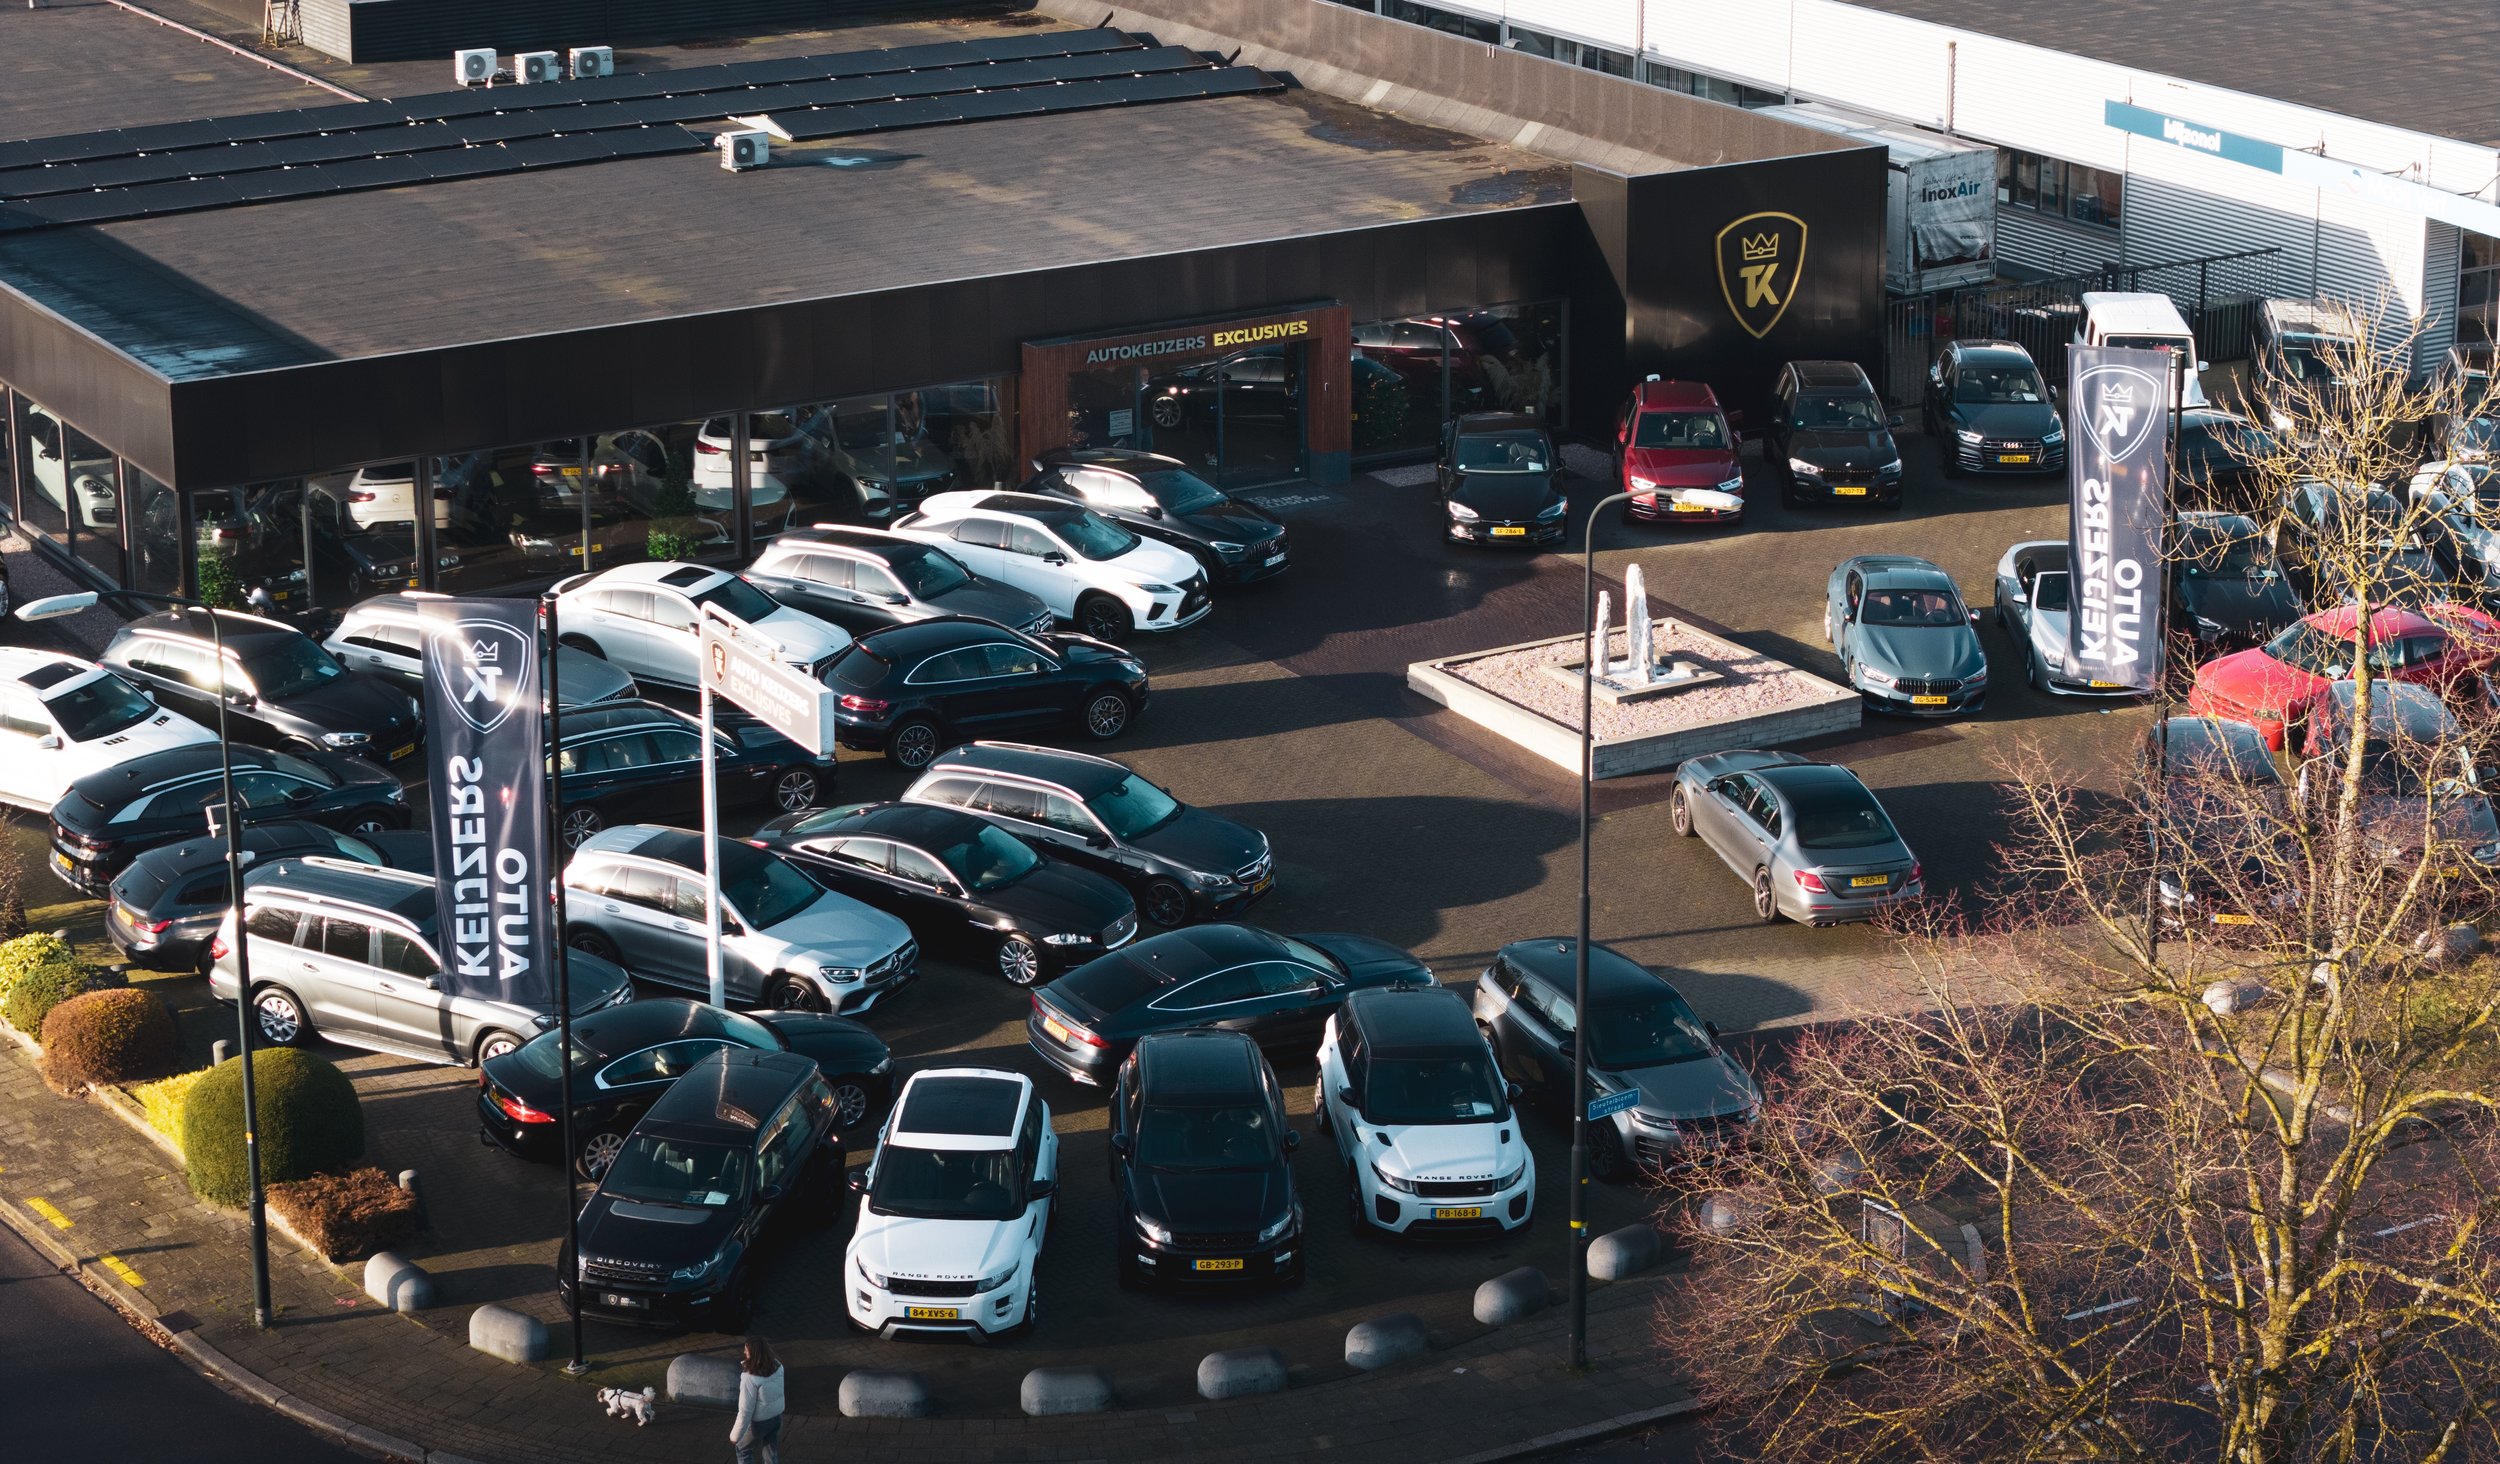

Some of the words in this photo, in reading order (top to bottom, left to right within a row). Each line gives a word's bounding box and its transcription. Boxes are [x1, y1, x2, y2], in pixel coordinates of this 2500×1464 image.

[1922, 180, 1981, 203] InoxAir
[1087, 335, 1206, 364] AUTOKEIJZERS
[1213, 320, 1309, 347] EXCLUSIVES
[730, 656, 760, 684] AUTO
[731, 675, 792, 726] EXCLUSIVES
[1855, 876, 1885, 885] T-560-TT
[1604, 1103, 1624, 1114] straat
[1439, 1209, 1477, 1217] PB-168-B
[596, 1256, 663, 1269] DISCOVERY
[1200, 1261, 1240, 1269] GB-293-P
[892, 1271, 929, 1279] RANGE
[912, 1308, 954, 1318] 84-XVS-6
